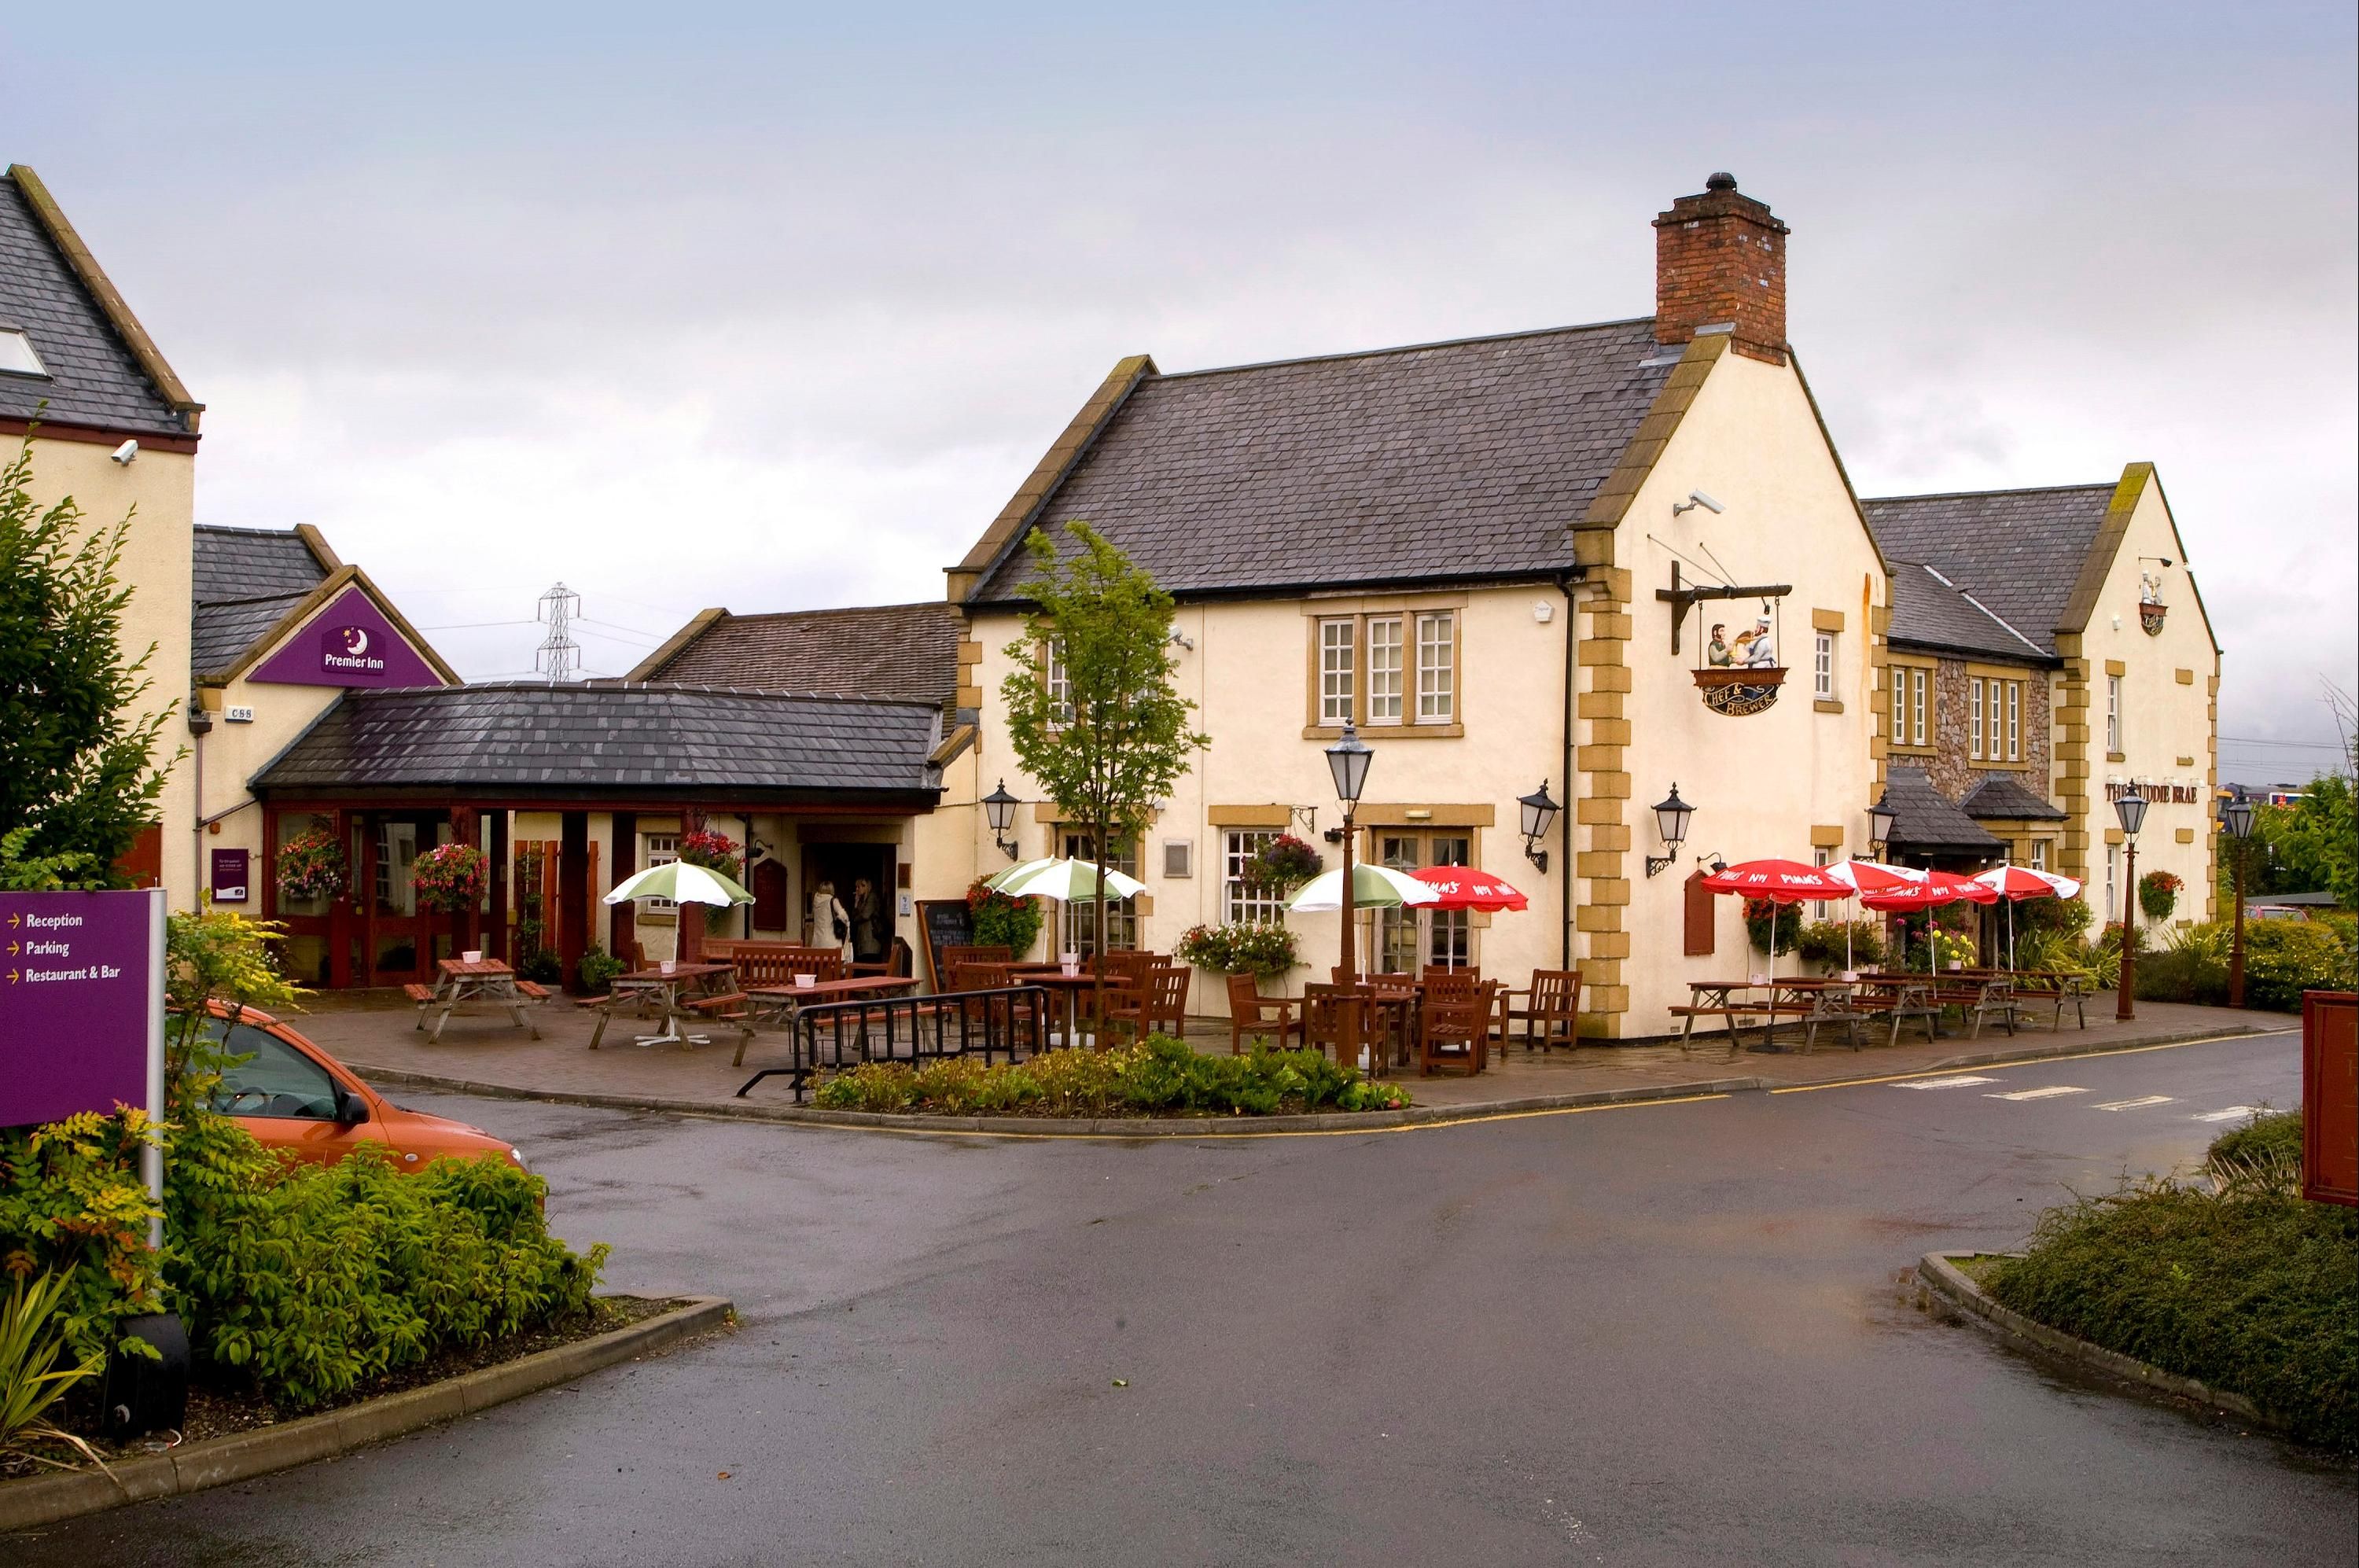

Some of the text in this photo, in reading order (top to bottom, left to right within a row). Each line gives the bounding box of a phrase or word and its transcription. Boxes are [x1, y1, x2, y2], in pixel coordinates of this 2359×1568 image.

[325, 653, 384, 669] Premier Inn
[1704, 684, 1742, 706] CHEF &
[1726, 694, 1773, 716] BREWER
[2135, 784, 2170, 803] UDDIE
[2172, 786, 2198, 804] BRAE
[27, 913, 83, 930] Reception
[26, 940, 70, 957] Parking
[26, 965, 120, 982] Restaurant & Bar
